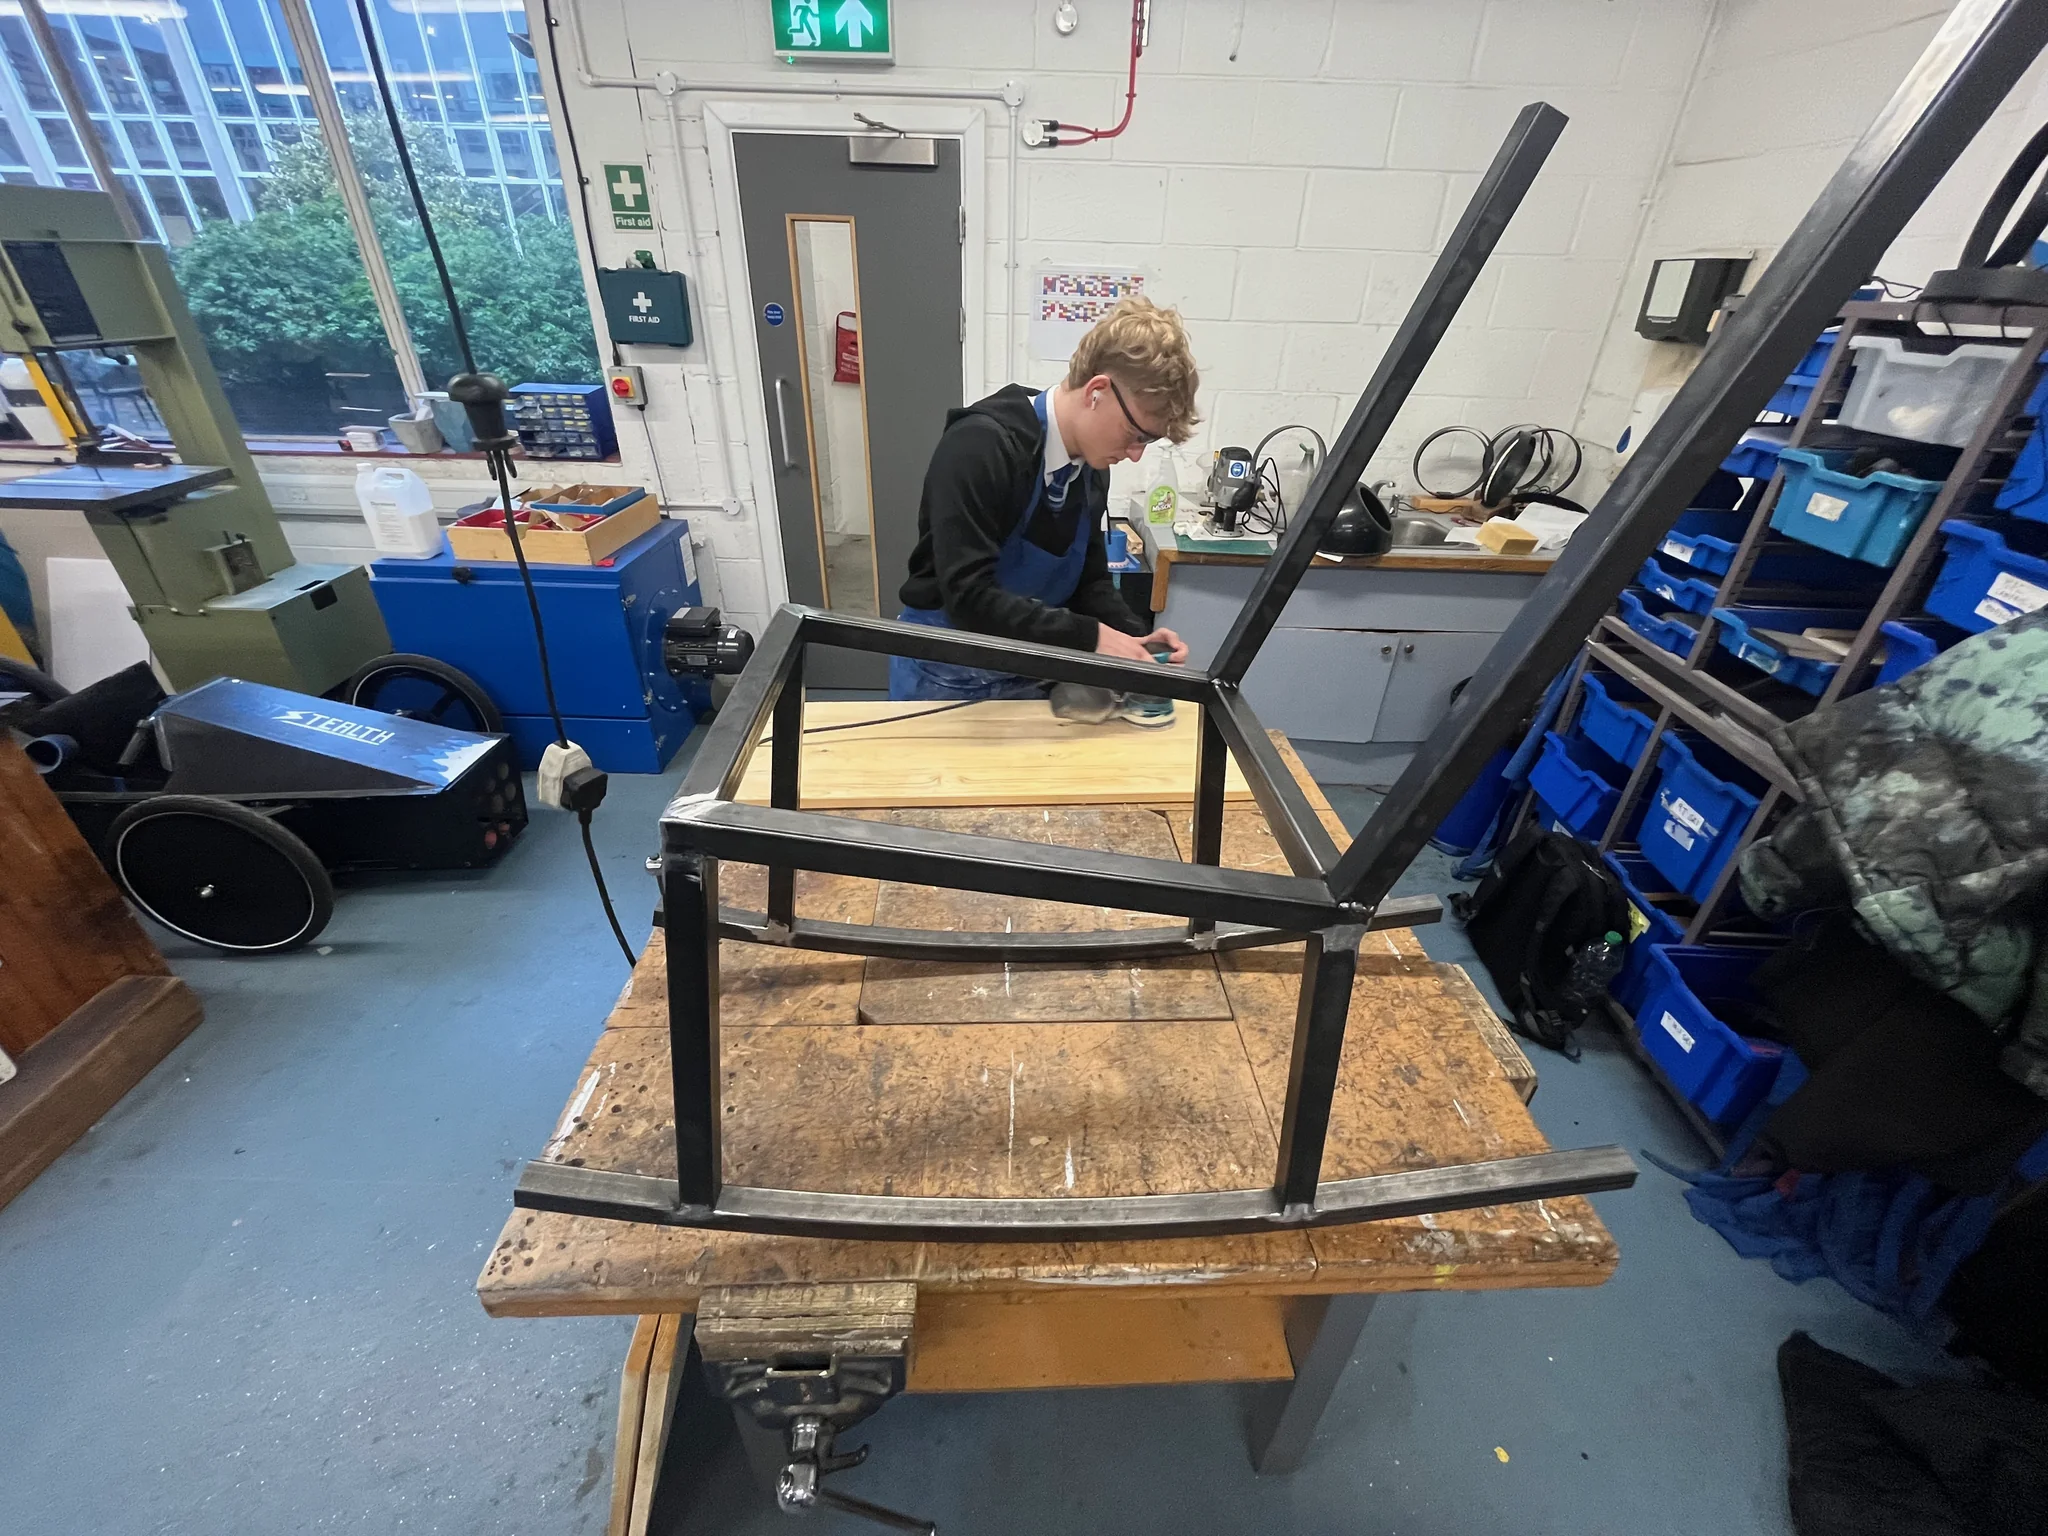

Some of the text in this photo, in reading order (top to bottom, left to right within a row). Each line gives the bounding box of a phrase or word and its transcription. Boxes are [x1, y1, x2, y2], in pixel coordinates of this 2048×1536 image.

[615, 216, 651, 227] First aid
[628, 315, 660, 324] FIRST AID
[271, 711, 395, 745] STEALTH
